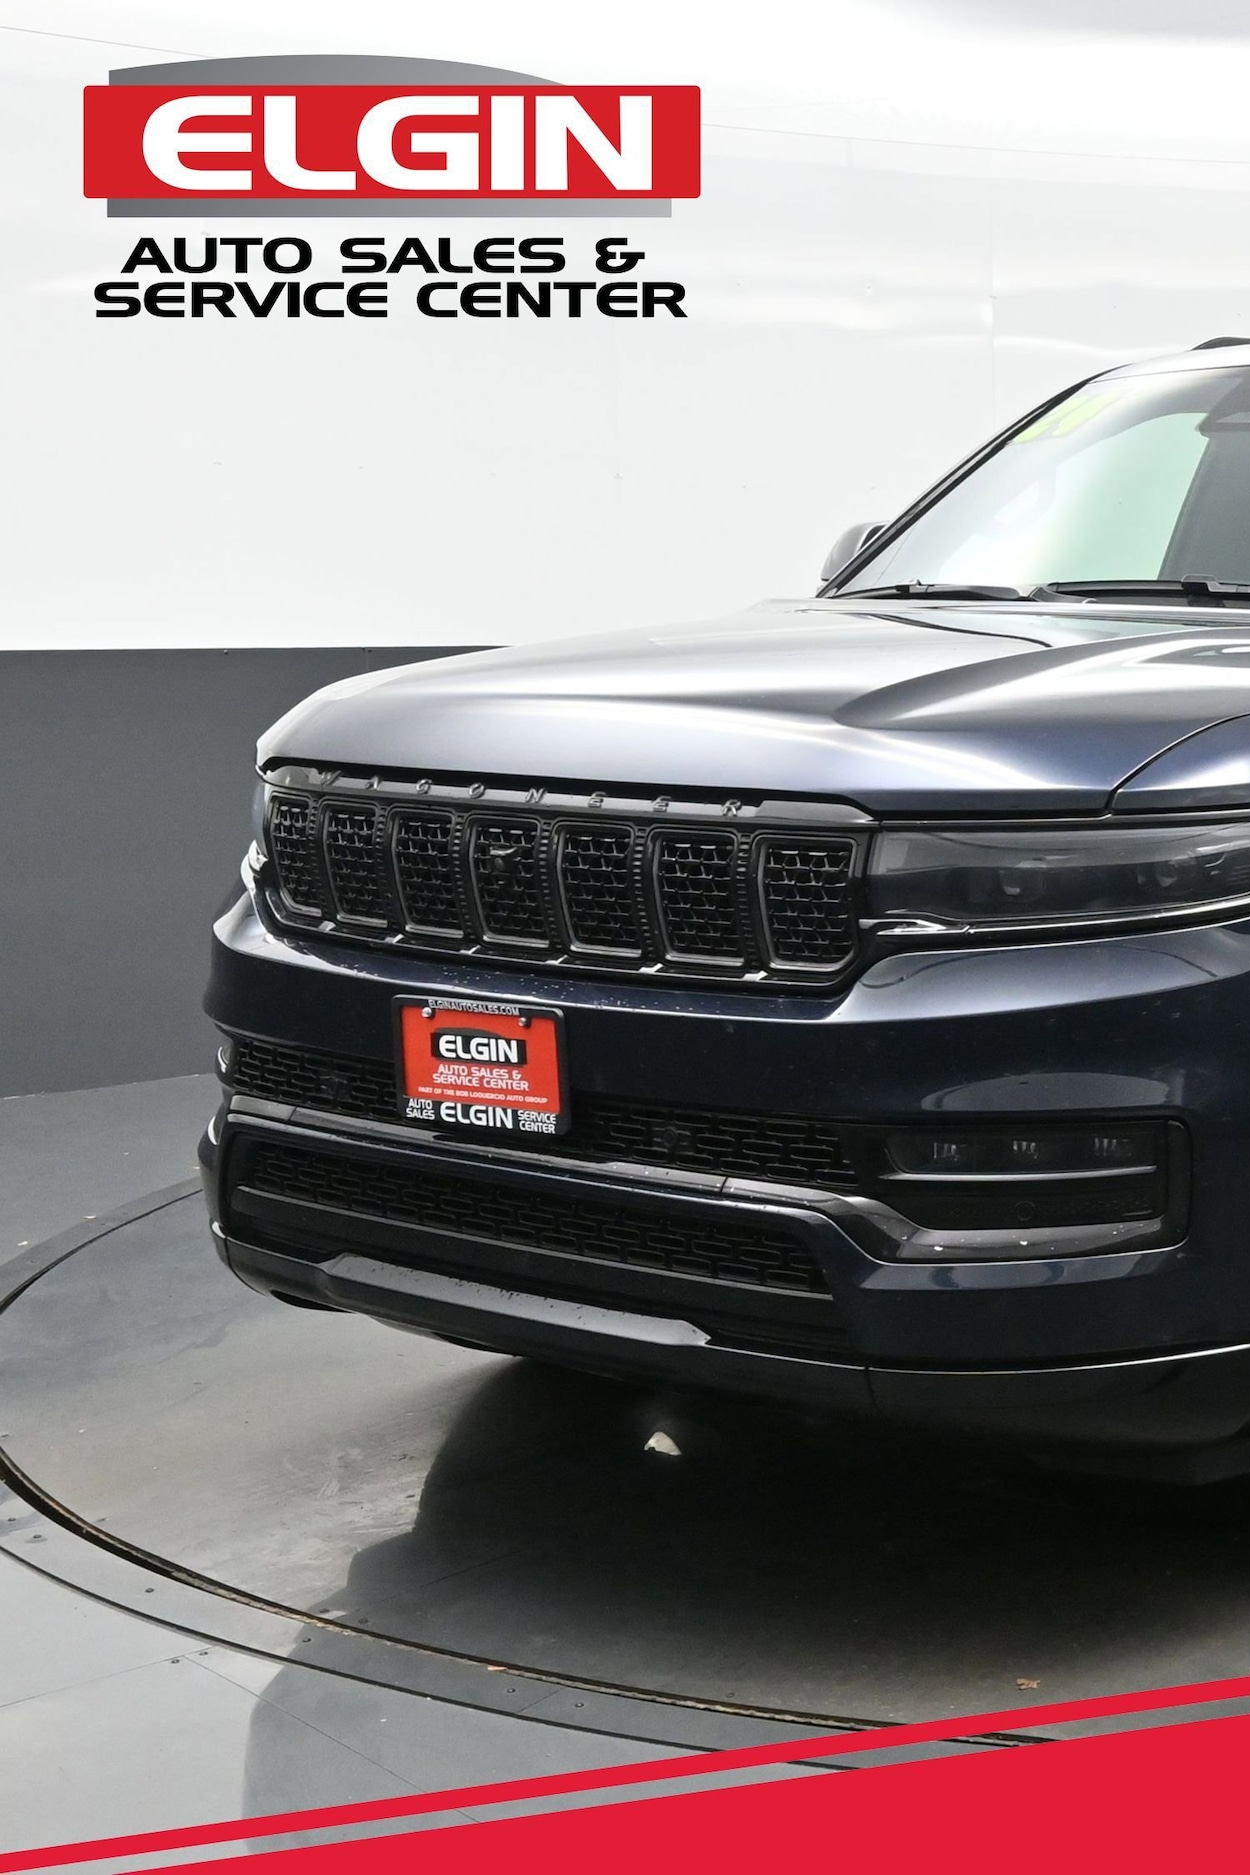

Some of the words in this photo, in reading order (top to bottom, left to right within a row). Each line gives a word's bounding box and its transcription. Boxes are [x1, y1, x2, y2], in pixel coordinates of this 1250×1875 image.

[319, 770, 741, 817] WAGONEER
[428, 1000, 519, 1016] ELGINAUTOSALES.COM
[438, 1035, 518, 1063] ELGIN
[437, 1064, 468, 1075] AUTO
[471, 1067, 509, 1079] SALES
[512, 1070, 521, 1080] &
[432, 1073, 480, 1086] SERVICE
[483, 1078, 529, 1091] CENTER
[408, 1098, 433, 1110] AUTO
[506, 1094, 524, 1102] AUTO
[524, 1096, 548, 1104] GROUP
[406, 1107, 435, 1120] SALES
[440, 1102, 513, 1129] ELGIN
[517, 1110, 556, 1124] SERVICE
[519, 1120, 556, 1134] CENTER
